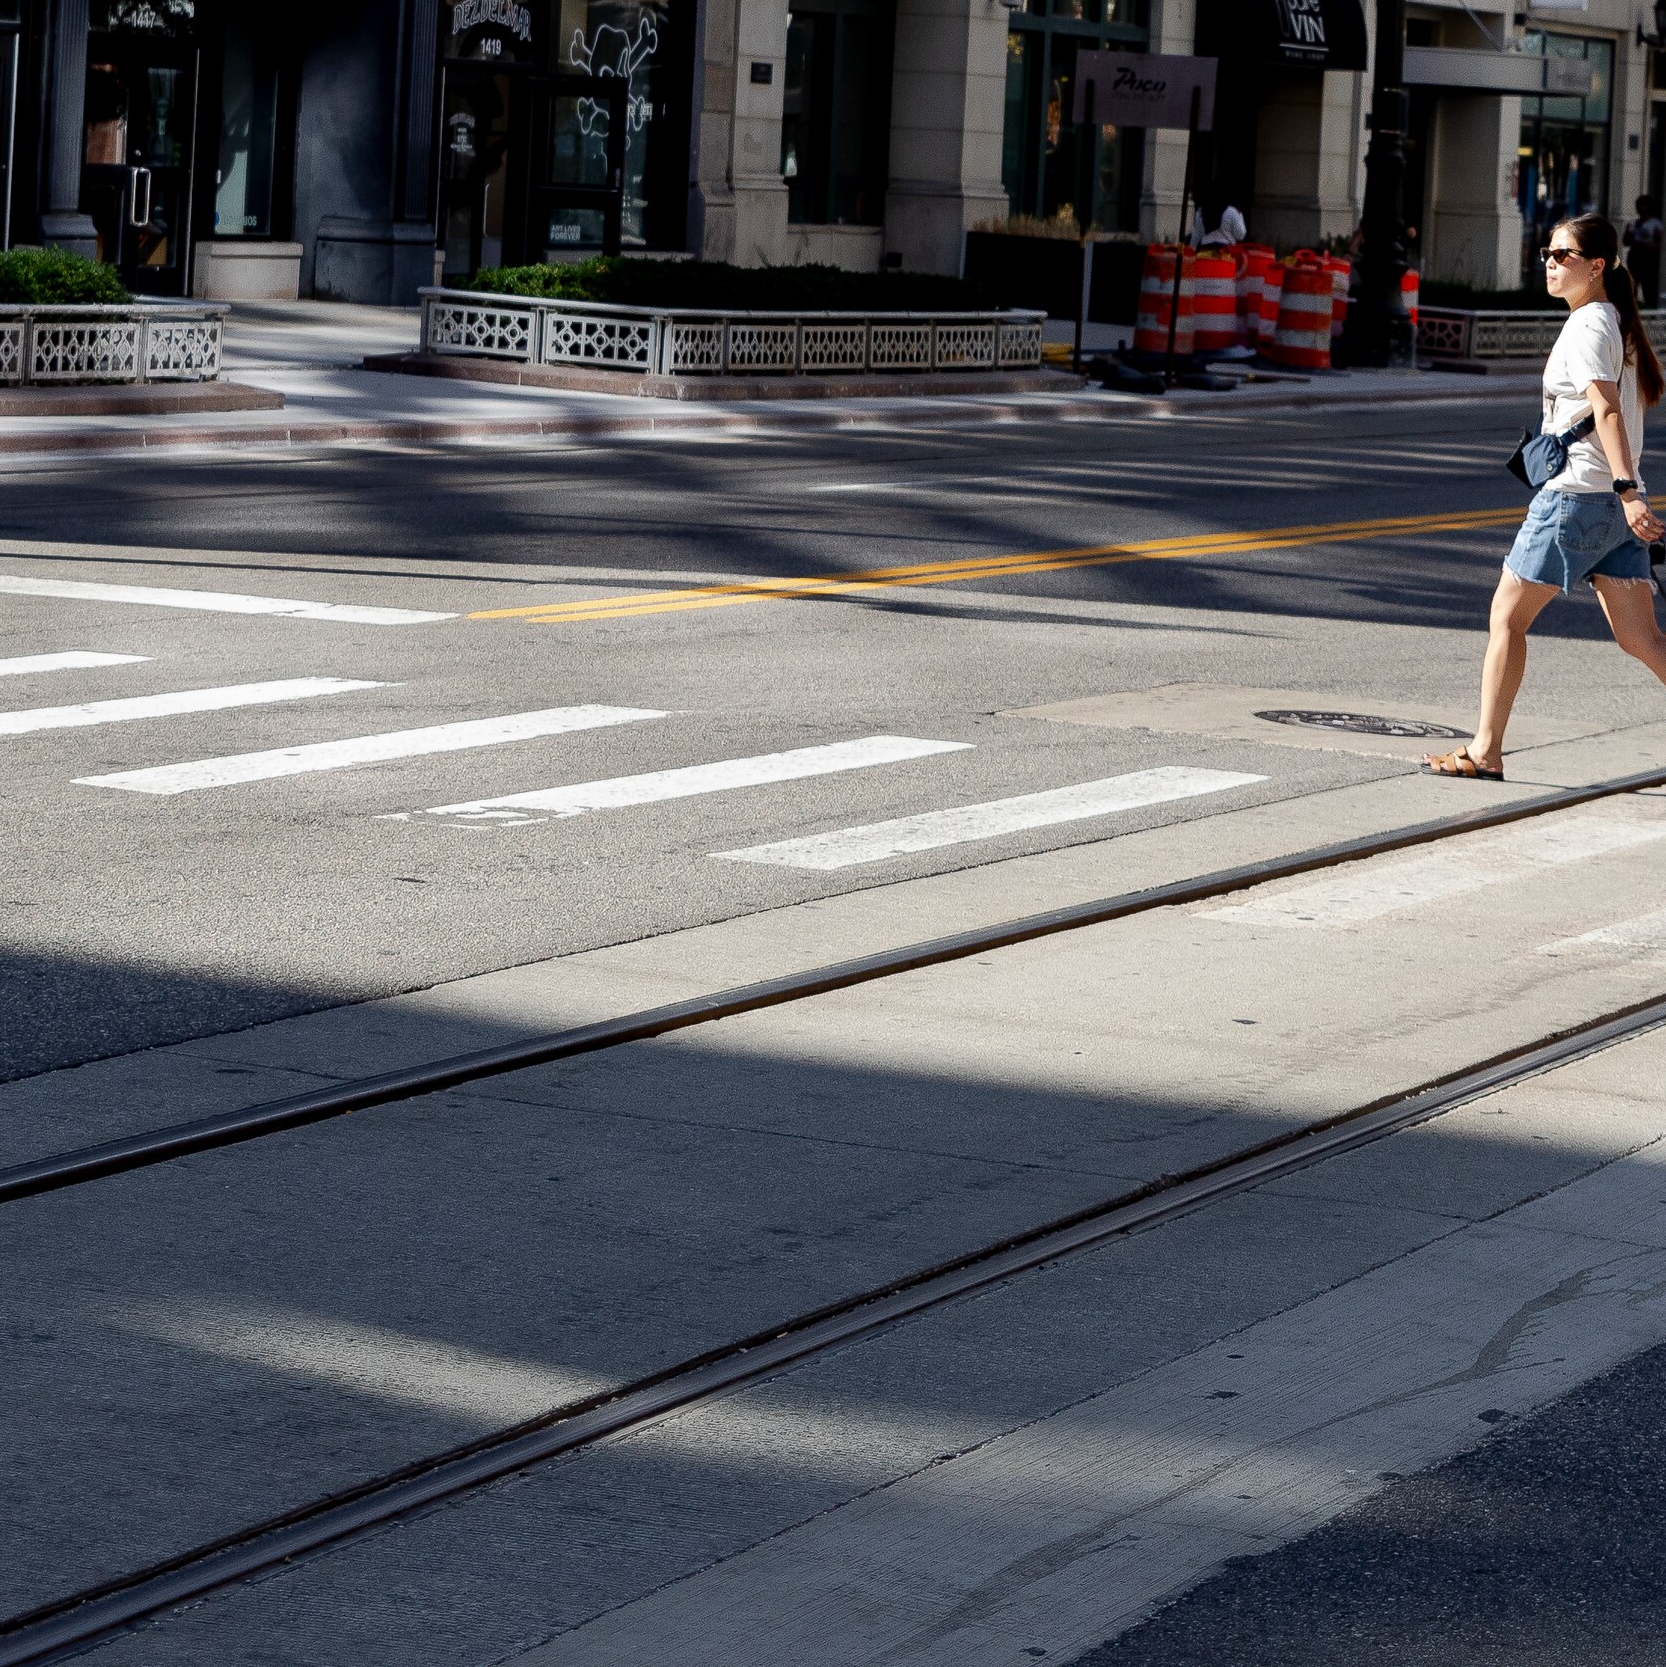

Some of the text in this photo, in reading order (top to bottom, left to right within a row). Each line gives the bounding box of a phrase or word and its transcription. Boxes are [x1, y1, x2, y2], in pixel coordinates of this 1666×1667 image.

[132, 10, 156, 29] 1417
[1290, 14, 1326, 43] VIN
[480, 38, 502, 56] 1419
